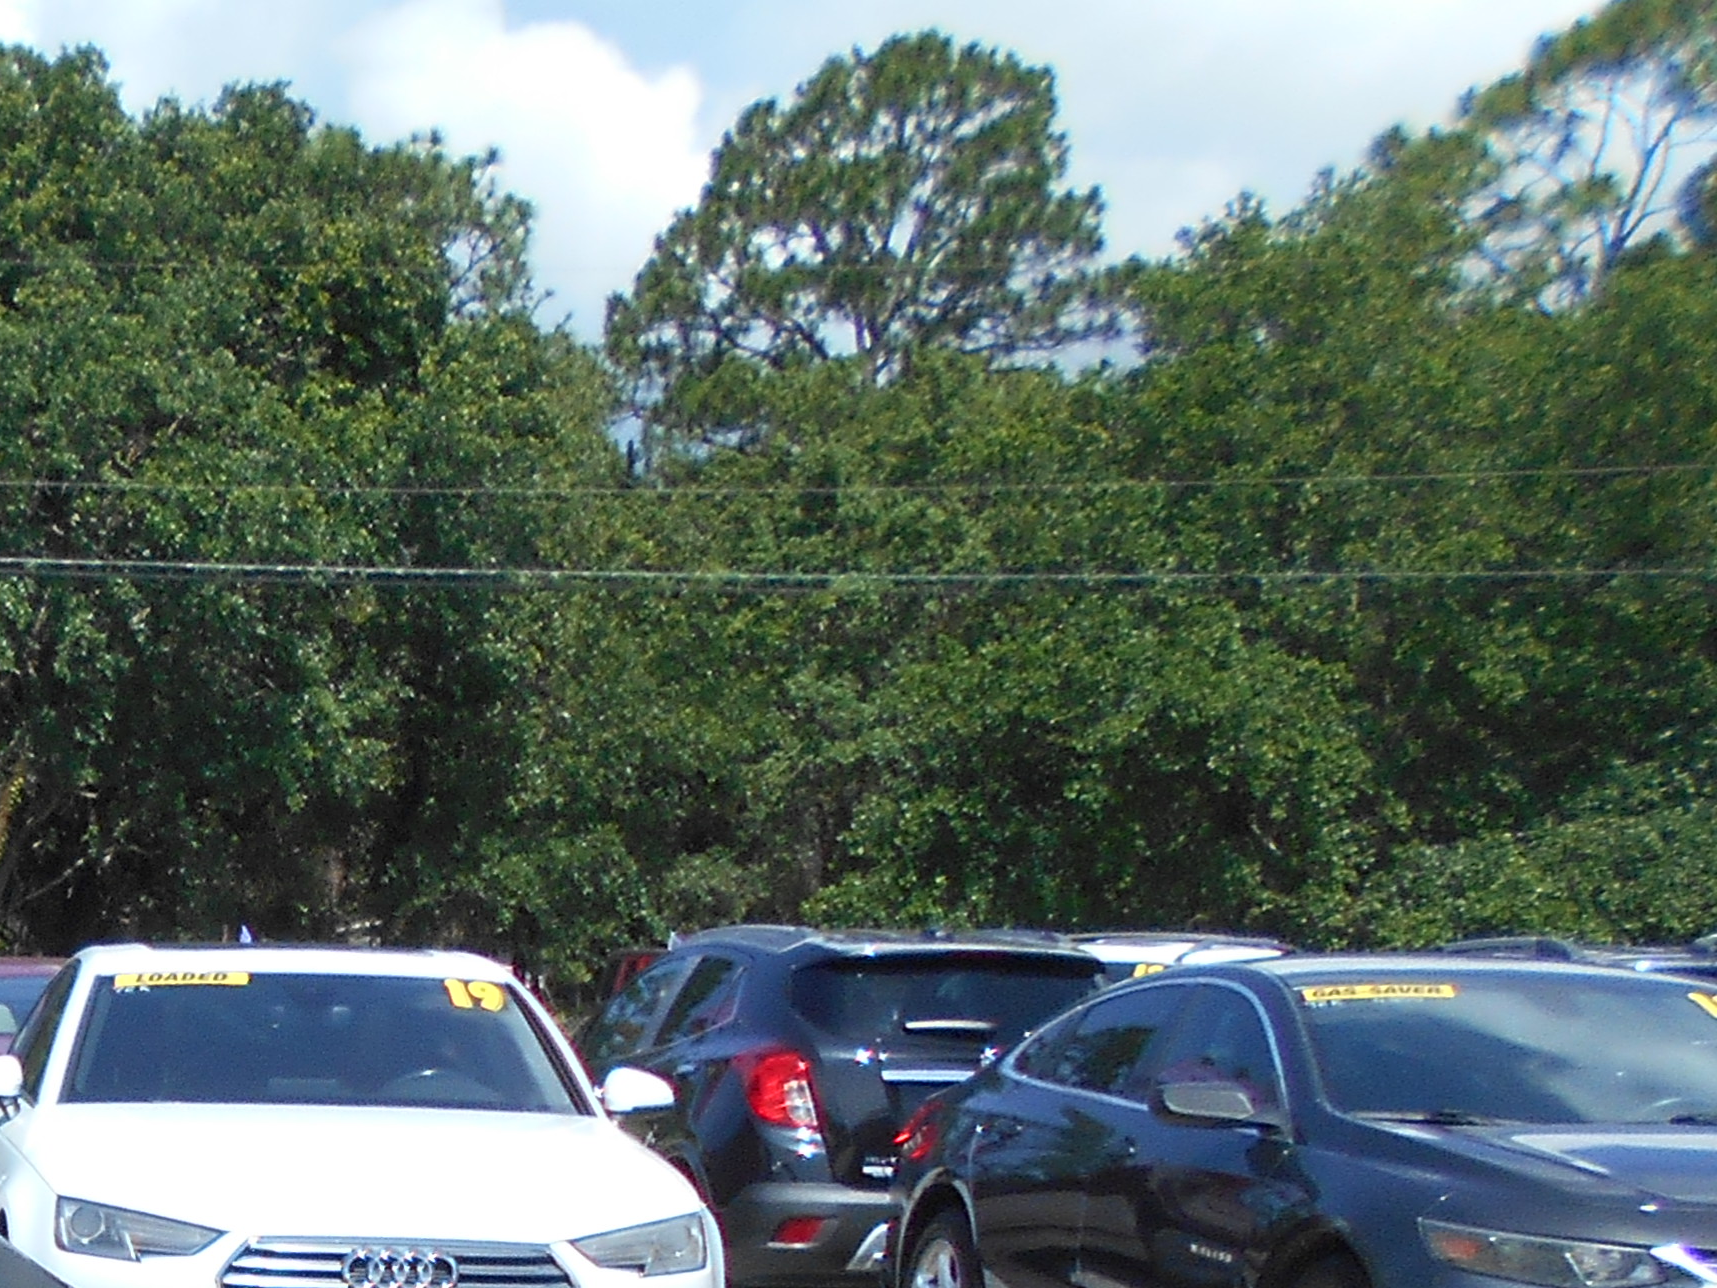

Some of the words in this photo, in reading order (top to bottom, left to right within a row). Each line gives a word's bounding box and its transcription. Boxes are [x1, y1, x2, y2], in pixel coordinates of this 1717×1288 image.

[134, 971, 229, 984] LOADED
[443, 977, 507, 1014] 19
[1311, 985, 1357, 998] GAS
[1369, 984, 1443, 996] SAVER
